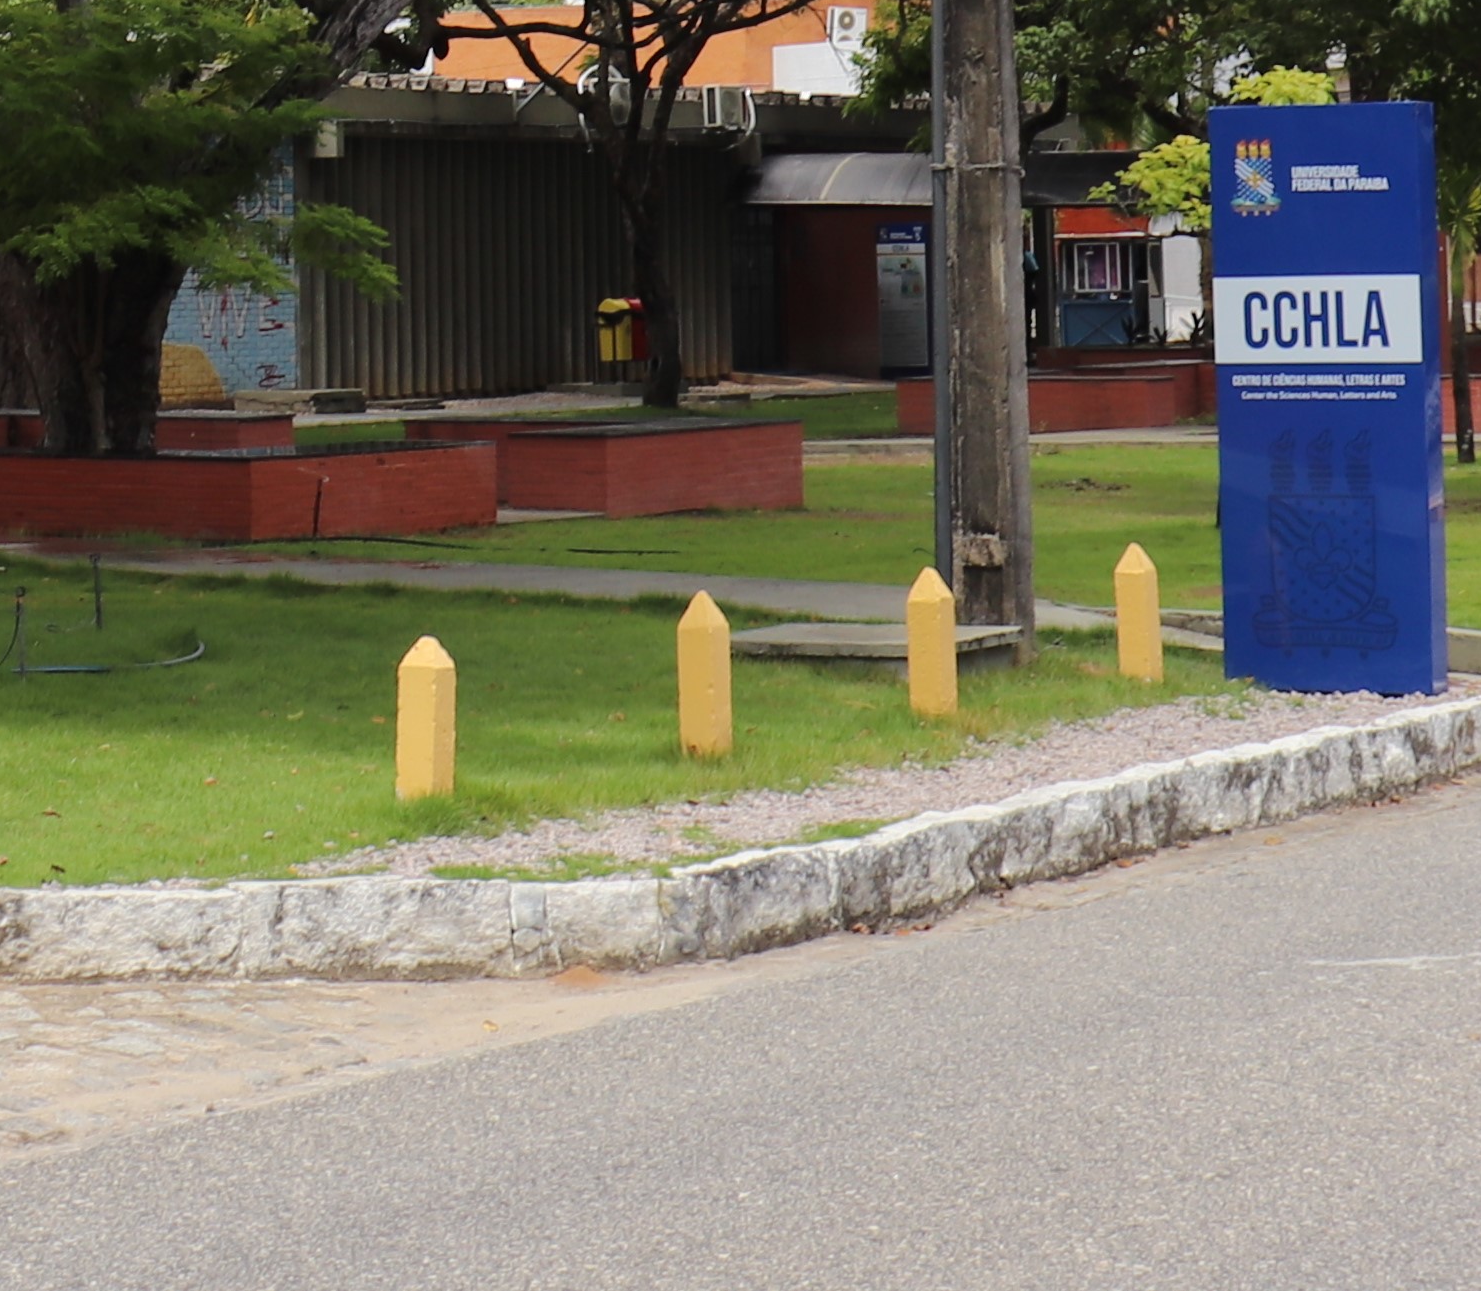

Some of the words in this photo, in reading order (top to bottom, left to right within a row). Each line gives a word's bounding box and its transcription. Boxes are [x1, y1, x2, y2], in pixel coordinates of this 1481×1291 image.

[1291, 165, 1359, 178] UNIVERSIDADE
[1291, 178, 1333, 192] FEDERAL
[1333, 178, 1347, 191] DA
[1243, 290, 1390, 349] CCHLA
[1232, 374, 1261, 386] CENTRO
[1261, 374, 1272, 386] DE
[1273, 372, 1306, 386] CIÊNCIAS
[1345, 374, 1374, 386] LETRAS
[1375, 374, 1381, 386] E
[1381, 374, 1405, 386] ARTES
[1241, 391, 1265, 400] Center
[1279, 391, 1310, 400] Sciences
[1366, 391, 1381, 400] and
[1381, 391, 1398, 400] Arts
